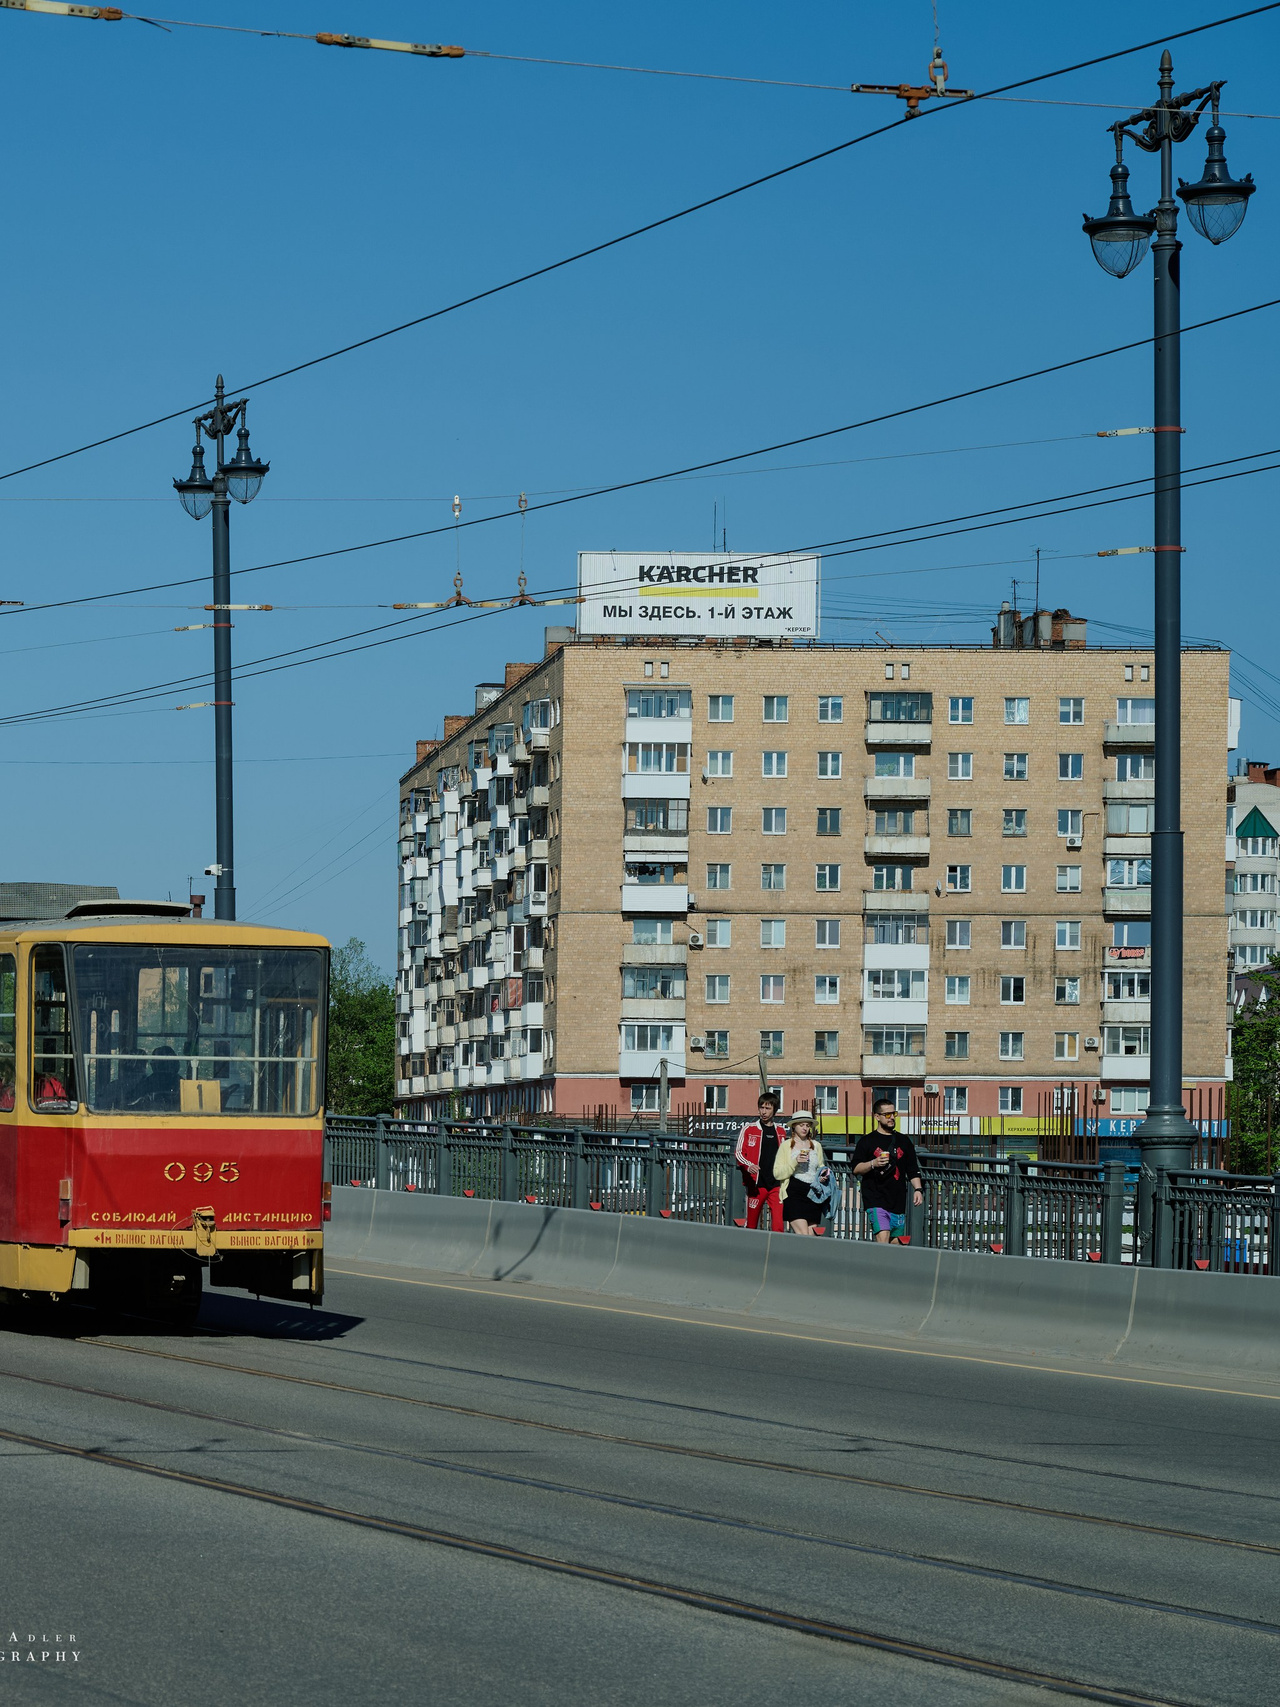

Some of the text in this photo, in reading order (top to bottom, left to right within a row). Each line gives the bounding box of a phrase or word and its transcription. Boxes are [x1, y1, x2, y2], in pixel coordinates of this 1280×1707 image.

[603, 603, 793, 621] МЫ ЗДЕСЬ. 1-Й ЭТАЖ
[197, 1083, 204, 1110] 1
[164, 1162, 240, 1182] 095
[91, 1210, 313, 1224] СОБЛЮДАЙ ДИСТАНЦИЮ
[115, 1233, 146, 1245] ВЫНОС
[149, 1234, 184, 1246] ВАГОНА
[230, 1235, 261, 1246] ВЫНОС
[264, 1235, 299, 1247] ВАГОНА
